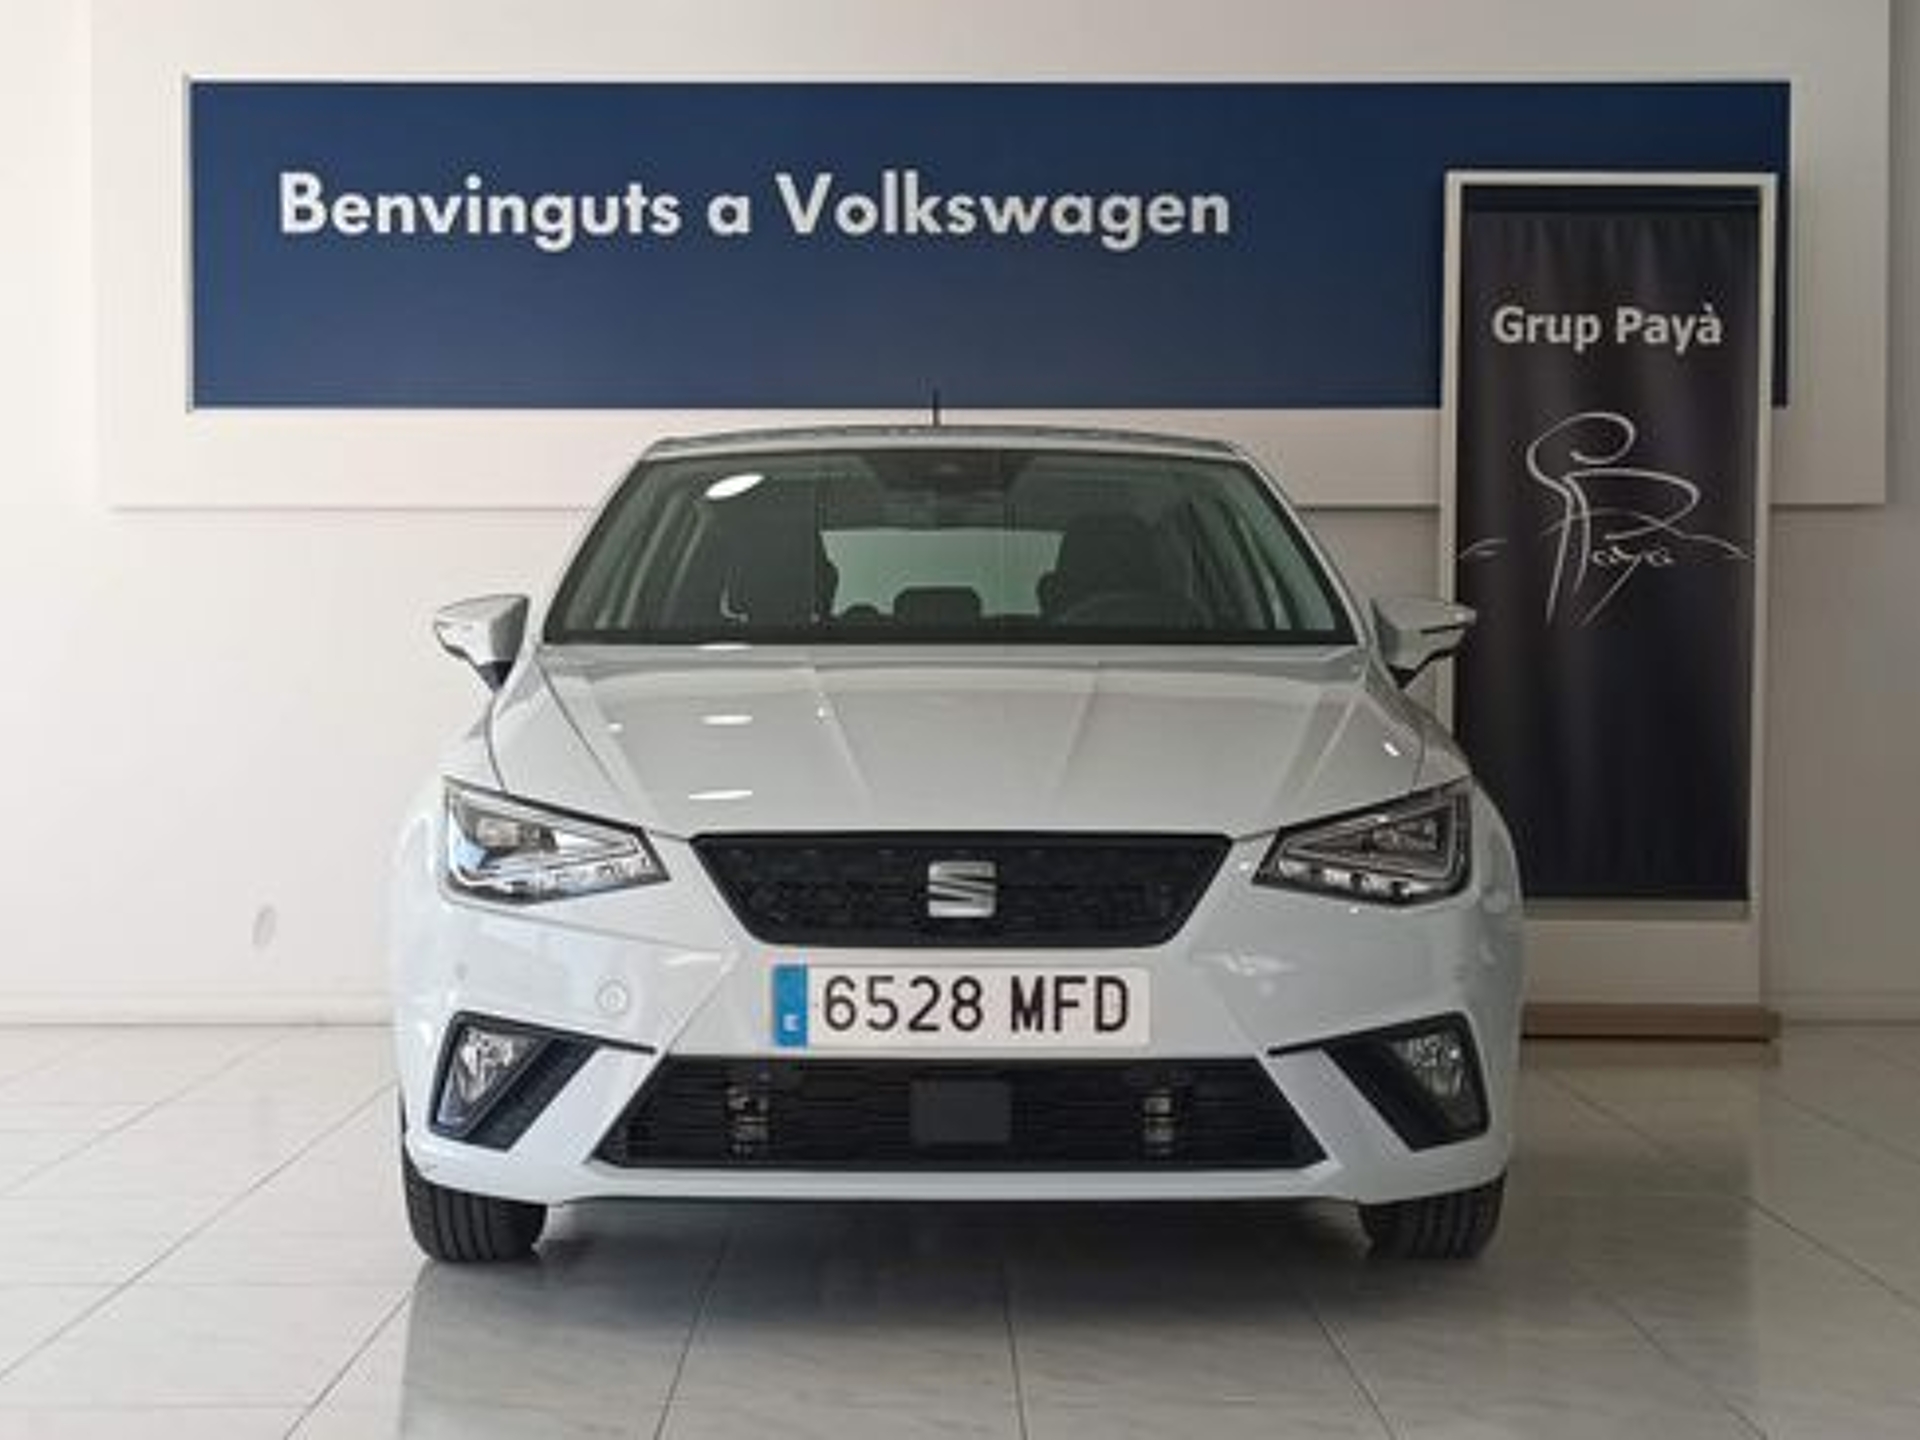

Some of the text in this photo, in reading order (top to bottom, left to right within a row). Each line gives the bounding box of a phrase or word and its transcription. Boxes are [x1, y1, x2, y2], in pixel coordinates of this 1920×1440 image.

[279, 169, 1230, 252] Benvinguts a Volkswagen
[1493, 302, 1723, 356] Grup Payà
[823, 974, 1130, 1033] 6528 MFD
